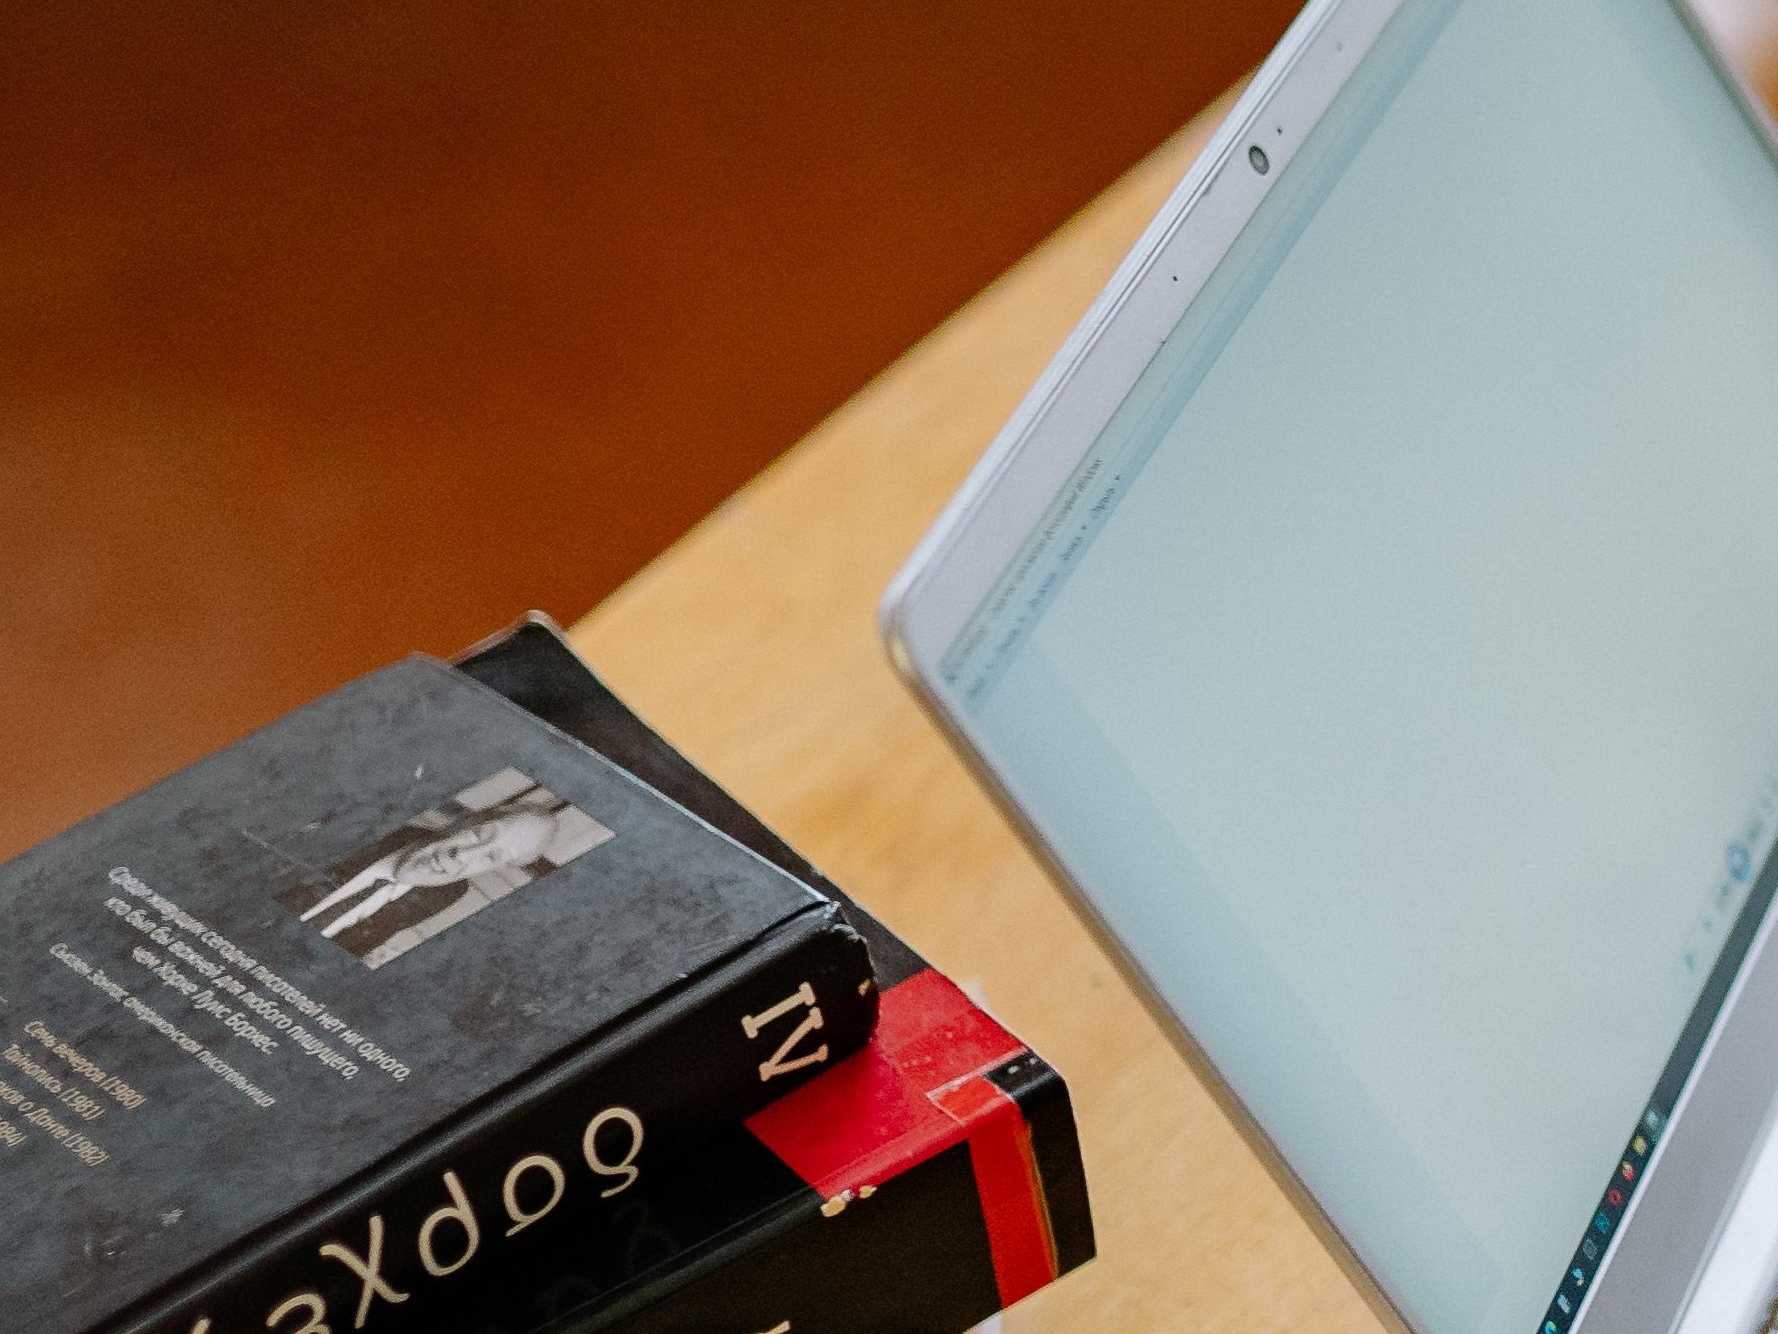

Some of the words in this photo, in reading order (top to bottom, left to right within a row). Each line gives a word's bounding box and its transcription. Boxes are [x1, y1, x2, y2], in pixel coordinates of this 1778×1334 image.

[191, 989, 231, 1018] Луис
[239, 991, 293, 1030] любого
[286, 1025, 360, 1081] пишущего,
[251, 964, 327, 1017] писателей
[316, 1013, 348, 1034] нет
[337, 1029, 365, 1047] ни
[357, 1042, 411, 1082] одного,
[741, 981, 829, 1083] IV
[57, 1087, 107, 1121] (1981)
[99, 1075, 147, 1110] (1980)
[61, 1132, 110, 1167] (1982)
